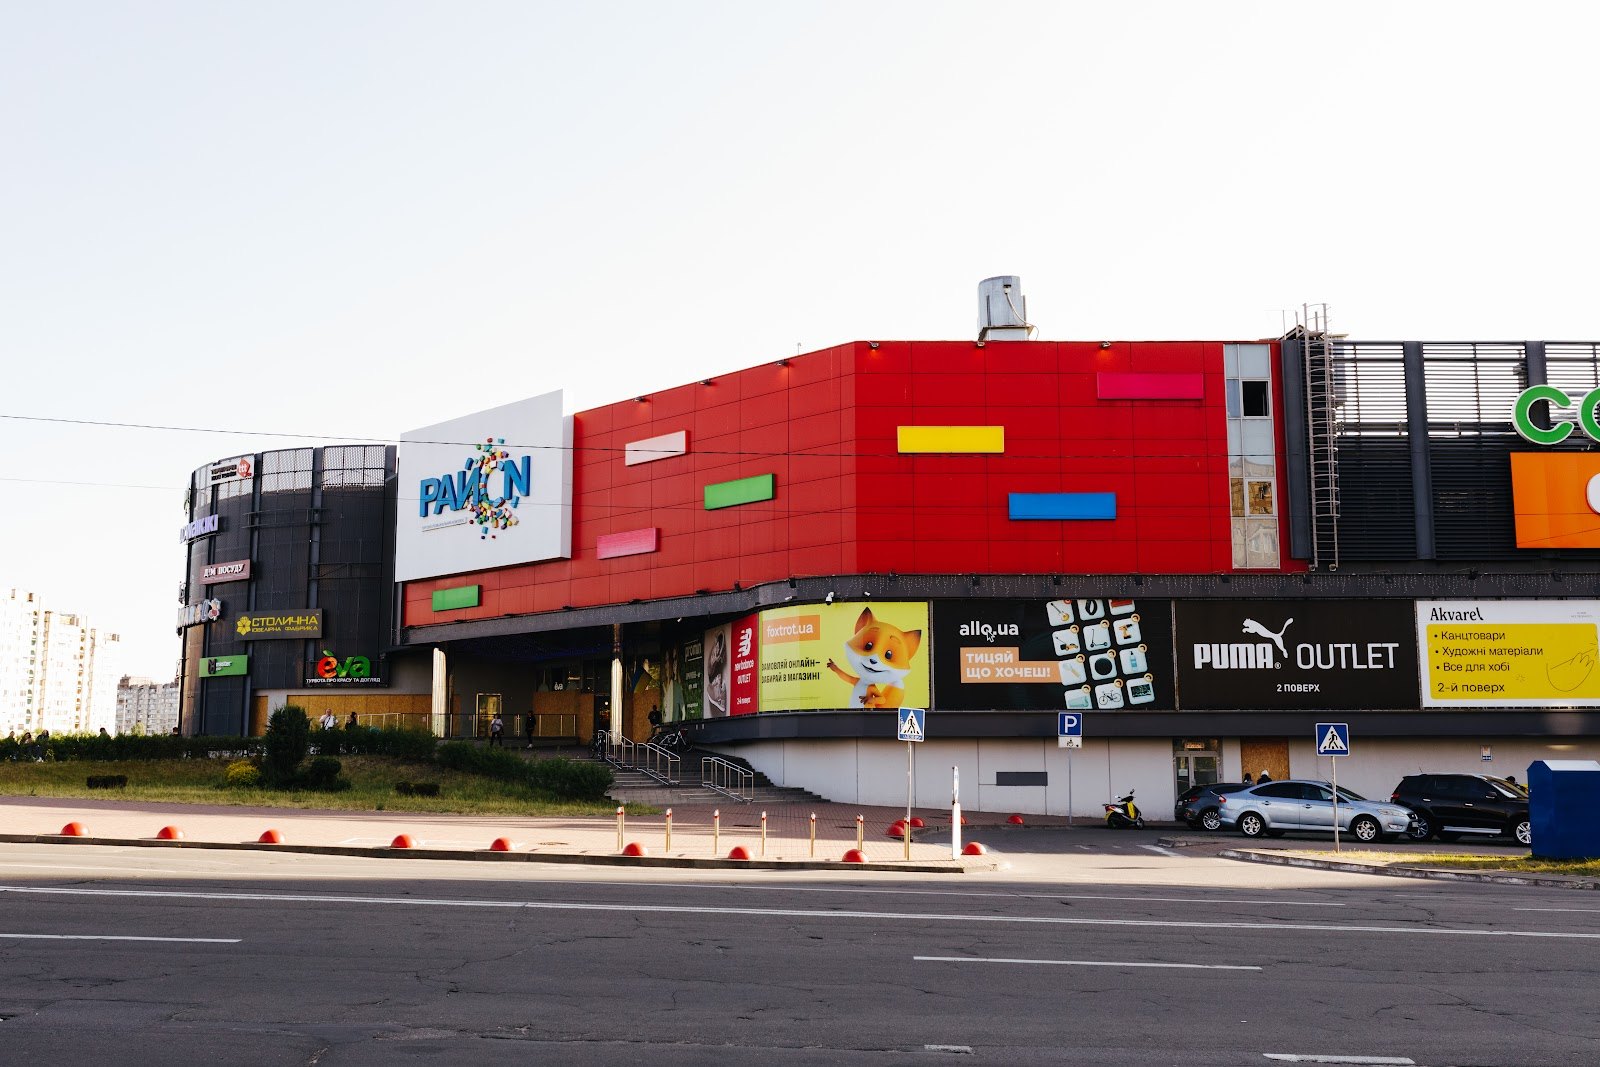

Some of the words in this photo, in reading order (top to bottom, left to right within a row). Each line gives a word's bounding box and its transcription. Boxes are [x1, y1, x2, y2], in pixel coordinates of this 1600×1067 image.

[218, 563, 244, 575] ПОСУДУ
[1430, 606, 1484, 621] Akvarel
[251, 615, 318, 627] СТОЛИЧНА
[766, 622, 814, 638] foxtrot.ua
[959, 621, 1019, 636] allo.ua
[1441, 631, 1506, 642] Канцтовари
[966, 650, 1013, 665] ТИЦЯЙ
[1296, 643, 1399, 670] OUTLET
[1442, 646, 1486, 656] Художні
[1489, 646, 1543, 657] матеріали
[762, 659, 788, 671] ЗАМОВЛЯЙ
[1443, 662, 1463, 671] Все
[1465, 664, 1486, 672] для
[1488, 662, 1510, 671] хобі
[762, 672, 782, 684] ЗАБИРАЙ
[783, 673, 787, 682] В
[787, 672, 820, 682] МАГАЗИНІ
[966, 667, 990, 679] ЩО
[995, 667, 1050, 678] ХОЧЕШ!
[1276, 683, 1282, 692] 2
[1284, 683, 1320, 693] ПОВЕРХ
[1437, 683, 1458, 693] 2-й
[1461, 684, 1505, 693] поверх
[1064, 715, 1077, 734] P
